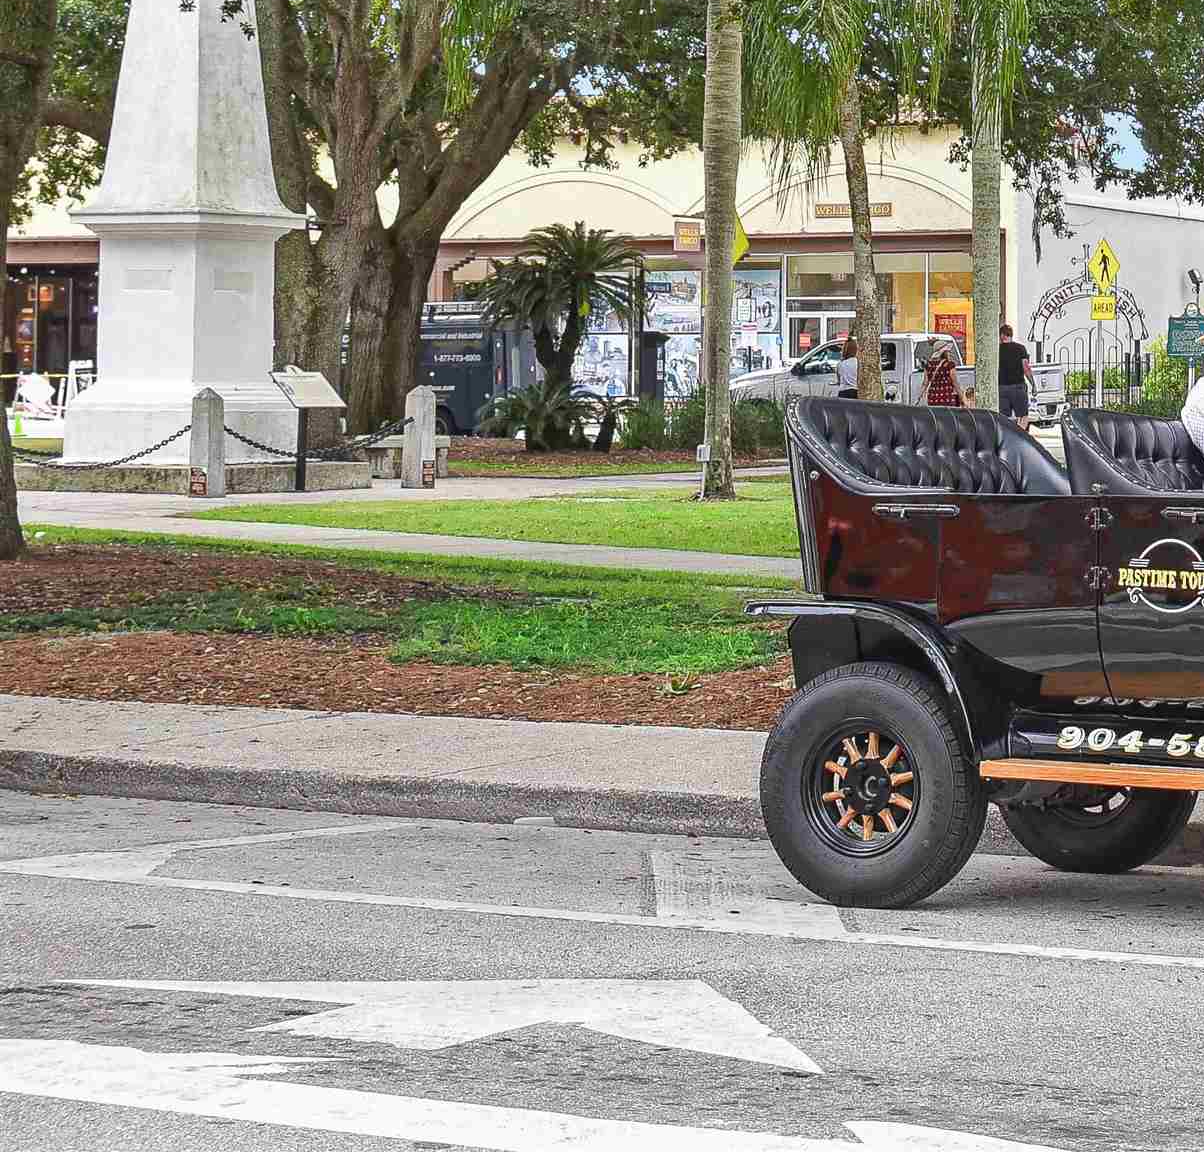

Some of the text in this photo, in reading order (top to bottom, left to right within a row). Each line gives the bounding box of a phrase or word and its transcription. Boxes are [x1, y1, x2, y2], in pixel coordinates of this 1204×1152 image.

[1040, 281, 1084, 320] TRINITY
[1093, 302, 1114, 313] AHEAD
[1118, 568, 1177, 589] PASTIME
